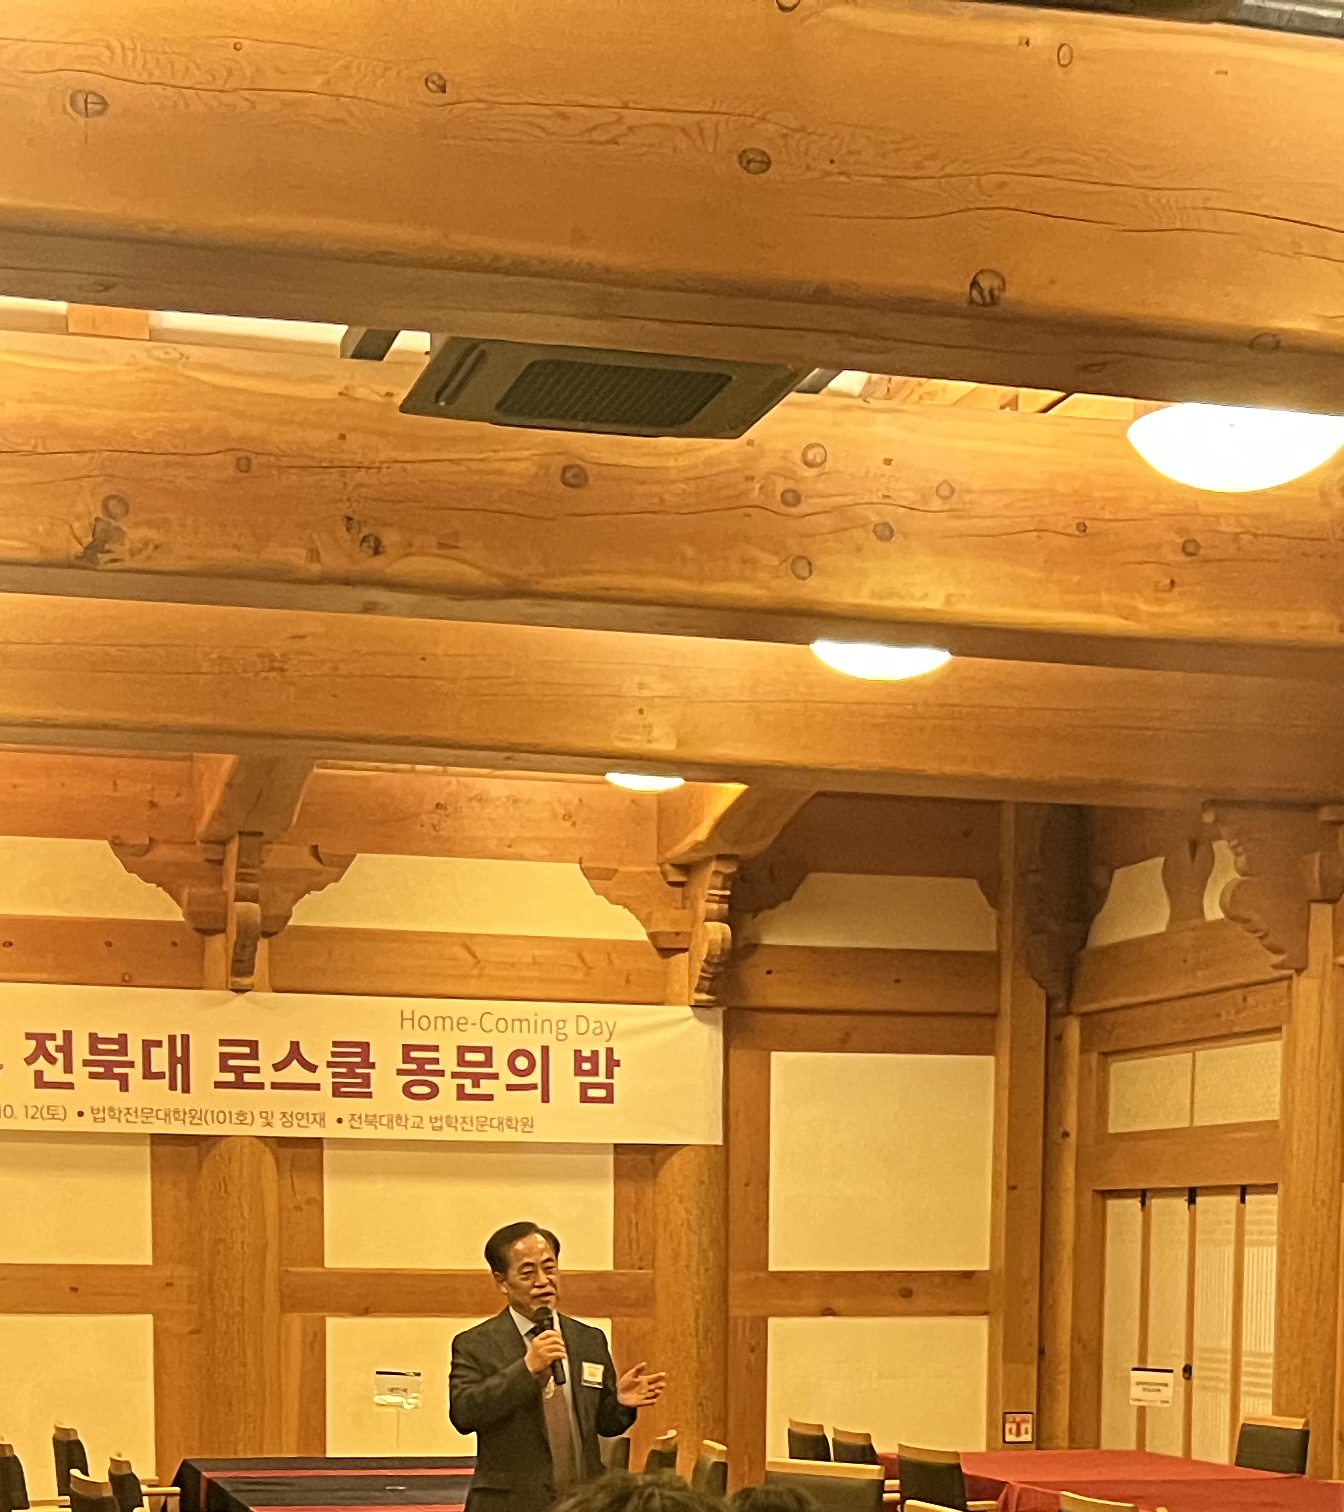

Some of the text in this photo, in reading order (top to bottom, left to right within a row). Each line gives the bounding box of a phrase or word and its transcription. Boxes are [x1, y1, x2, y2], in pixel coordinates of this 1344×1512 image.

[400, 1009, 618, 1042] Home-Coming Day
[23, 1029, 191, 1094] 전북대
[213, 1038, 376, 1099] 로스쿨
[395, 1043, 551, 1104] 동문의
[573, 1046, 621, 1105] 밤
[23, 1104, 68, 1122] 12(토)
[90, 1105, 255, 1127] 법학전문대학원(101호)
[259, 1110, 275, 1129] 및
[348, 1112, 535, 1134] 전북대학교 법학전문대학원
